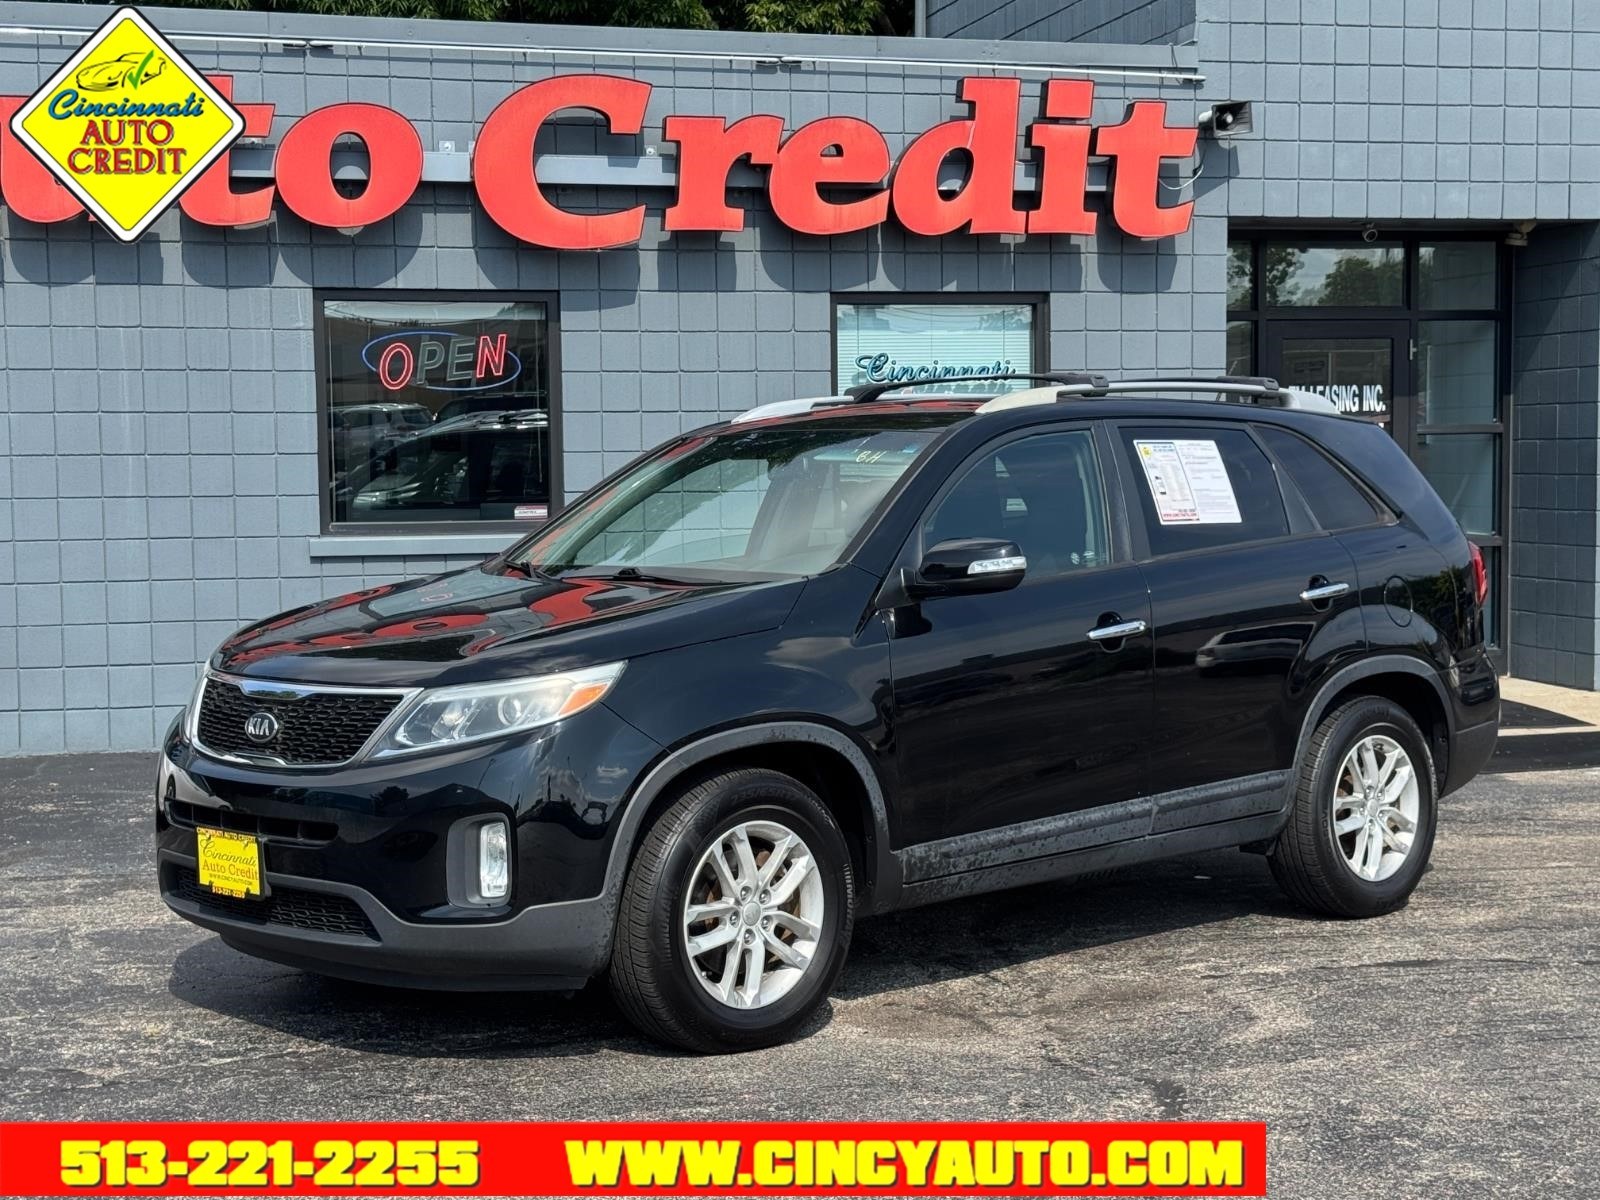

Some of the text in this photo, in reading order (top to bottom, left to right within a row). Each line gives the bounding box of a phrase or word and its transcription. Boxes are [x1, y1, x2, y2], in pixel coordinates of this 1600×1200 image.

[473, 74, 1199, 250] Credit
[379, 333, 507, 390] OPEN
[855, 352, 1017, 382] Cincinnati
[1309, 384, 1387, 412] ASING INC.
[248, 717, 270, 736] KIA
[200, 839, 257, 867] Cincinnati
[202, 859, 258, 881] Auto Credit
